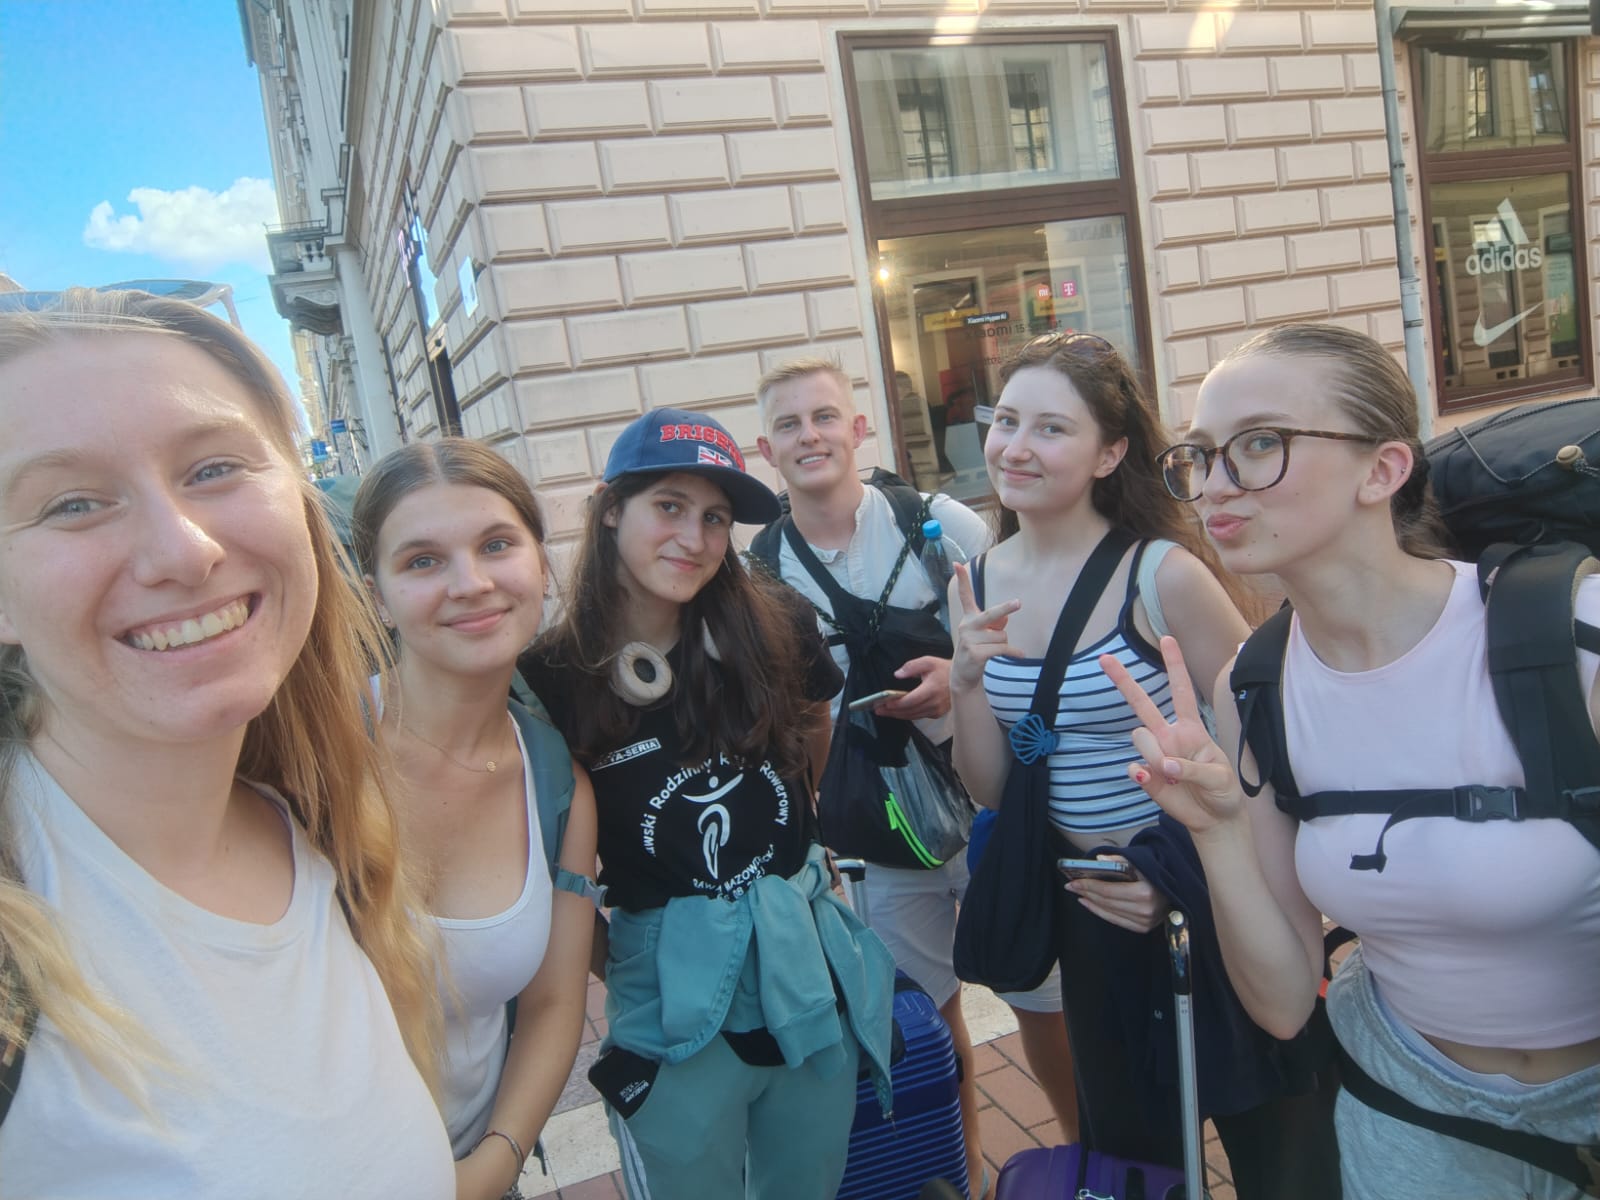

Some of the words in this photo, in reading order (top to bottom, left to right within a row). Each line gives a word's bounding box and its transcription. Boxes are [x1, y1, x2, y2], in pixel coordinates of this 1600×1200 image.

[1465, 245, 1542, 275] adidas
[1063, 282, 1074, 296] T
[760, 759, 789, 826] Rowerowy
